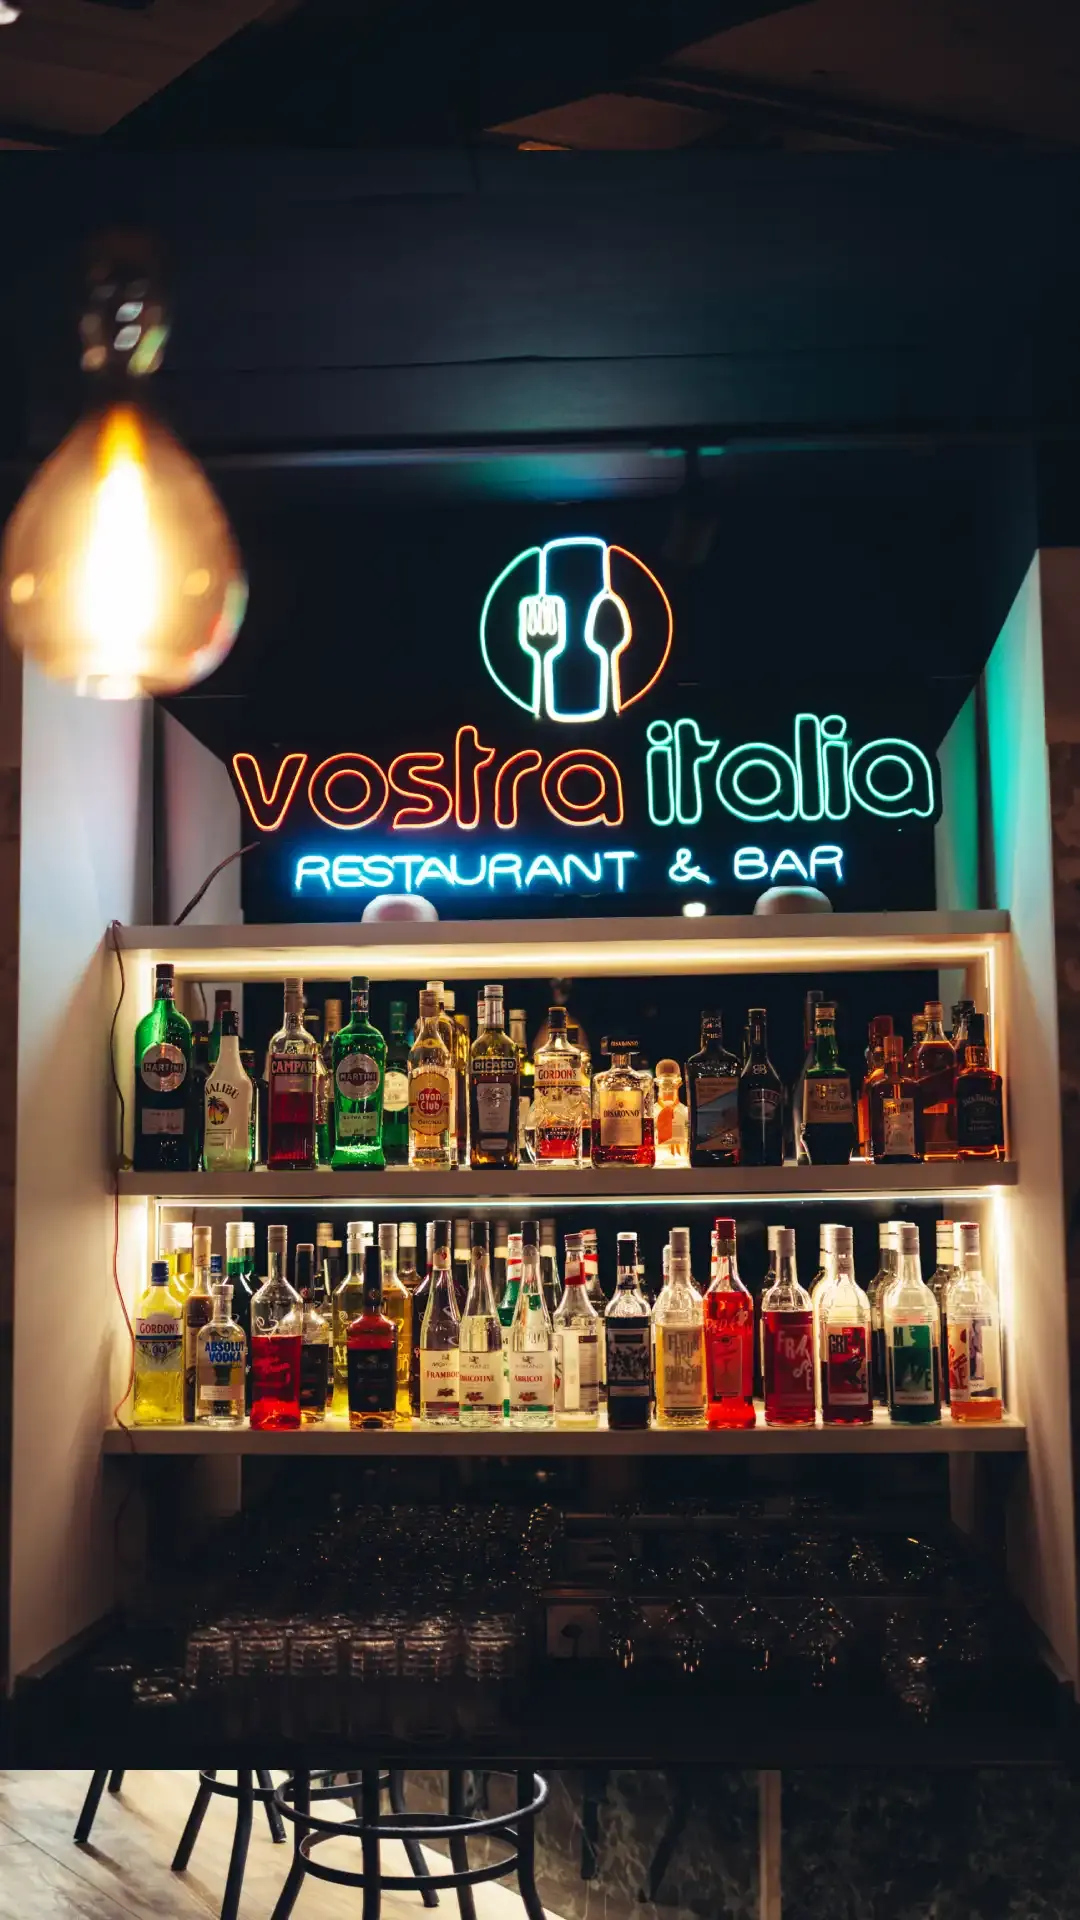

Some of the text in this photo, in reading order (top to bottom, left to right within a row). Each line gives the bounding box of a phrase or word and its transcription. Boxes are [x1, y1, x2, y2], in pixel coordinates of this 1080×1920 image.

[232, 713, 937, 832] vostra italia
[294, 845, 845, 892] RESTAURANT & BAR
[144, 1062, 183, 1073] MARTINI
[271, 1060, 317, 1074] CAMPARI
[474, 1060, 514, 1070] RICARD
[339, 1071, 377, 1081] MARTINI
[420, 1101, 440, 1111] Club
[204, 1341, 245, 1352] ABSOLUT
[208, 1351, 242, 1363] VODKA
